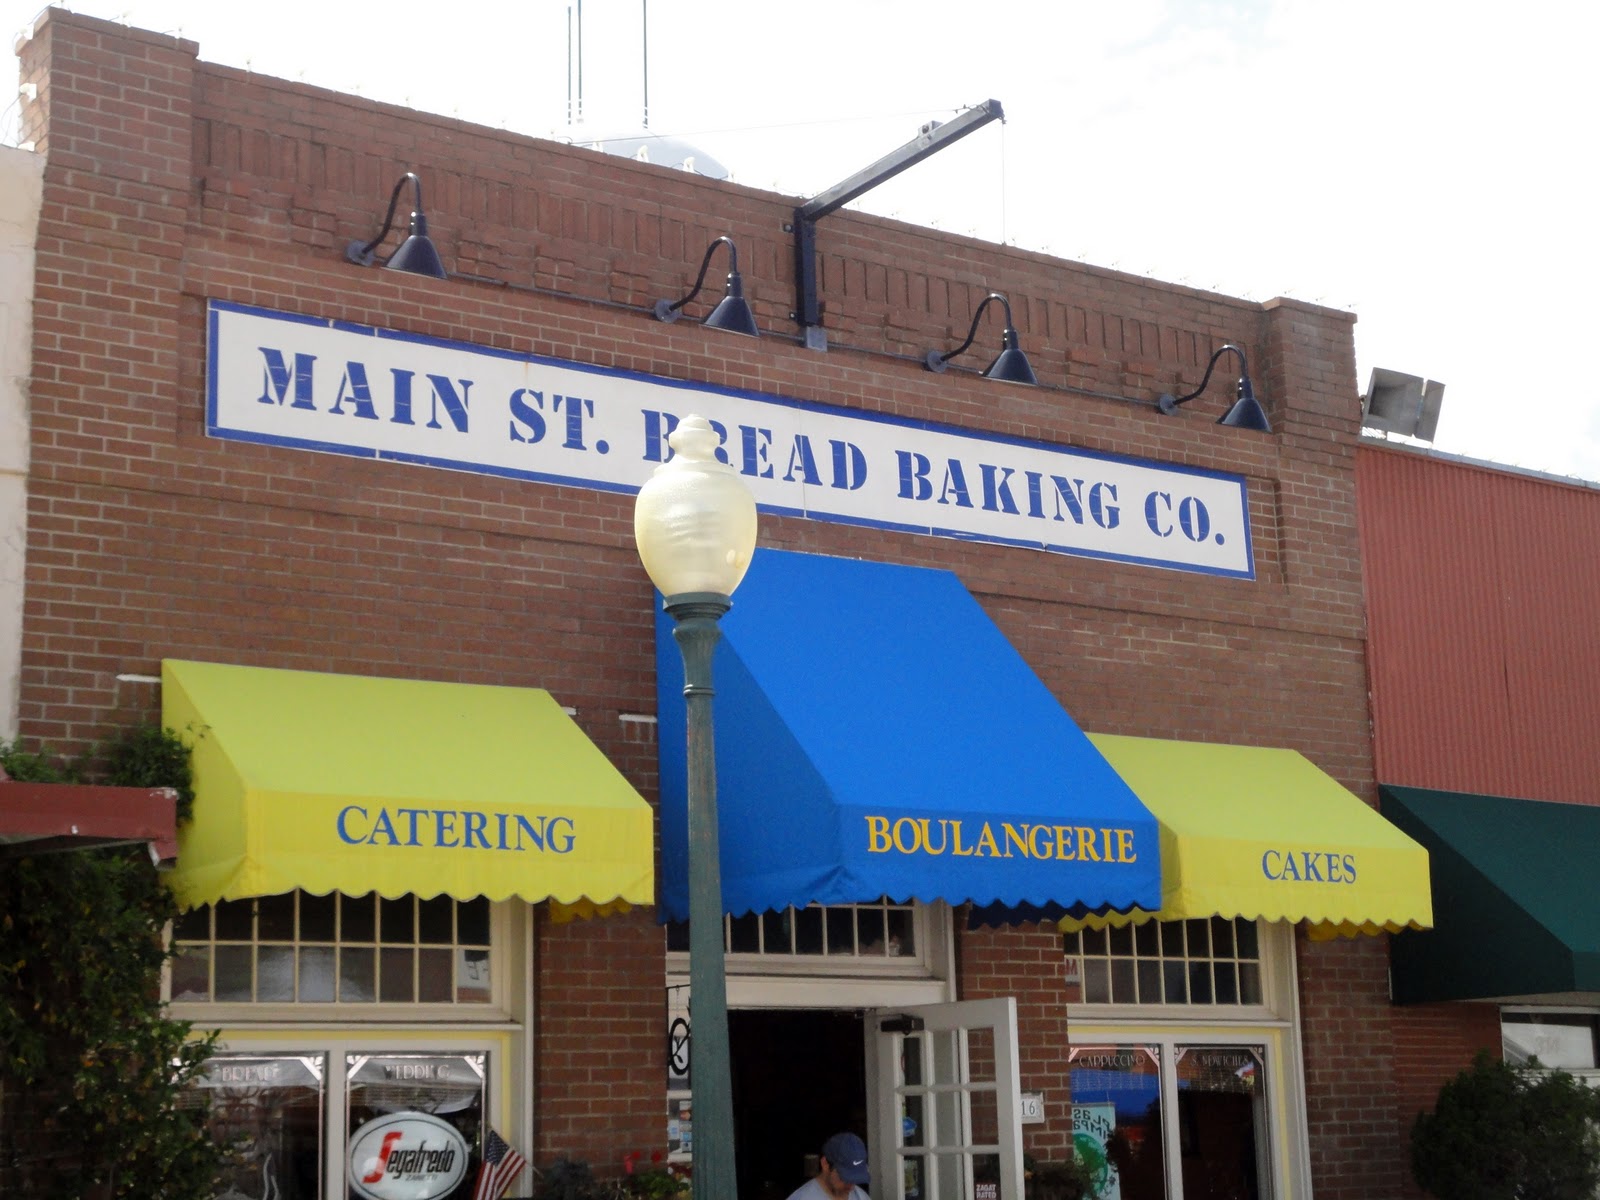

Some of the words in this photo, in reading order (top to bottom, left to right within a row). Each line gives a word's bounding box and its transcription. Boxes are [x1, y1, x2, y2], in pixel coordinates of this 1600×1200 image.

[257, 347, 474, 433] MAIN
[509, 387, 610, 454] ST.
[895, 449, 1120, 530] BAKING
[1144, 490, 1225, 546] CO.
[336, 805, 576, 854] CATERING
[864, 815, 1137, 864] BOULANGERIE
[1262, 850, 1357, 884] CAKES
[362, 1131, 456, 1183] Segafredo
